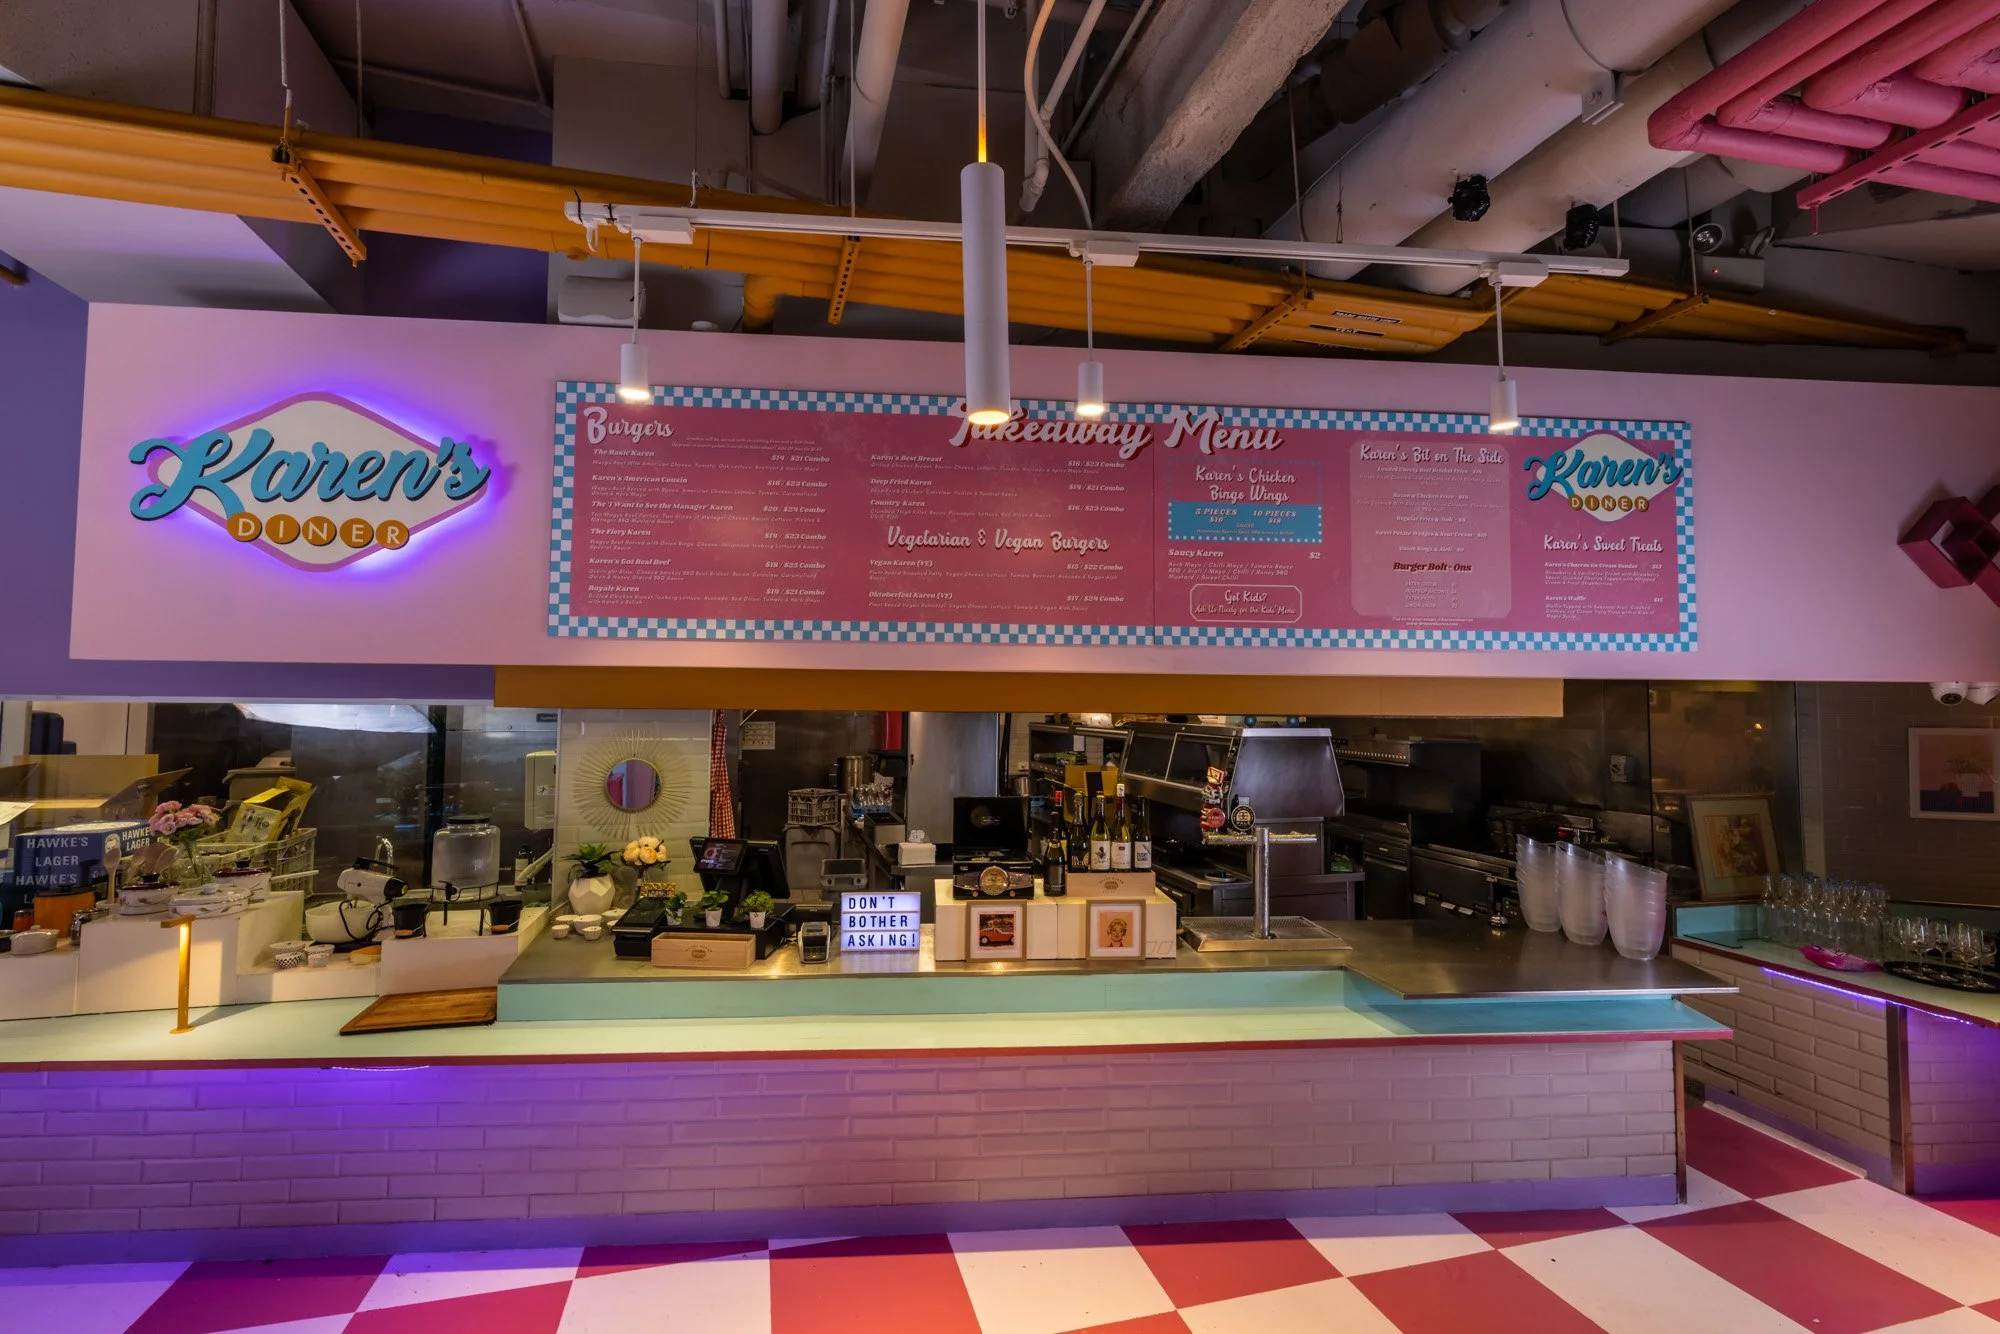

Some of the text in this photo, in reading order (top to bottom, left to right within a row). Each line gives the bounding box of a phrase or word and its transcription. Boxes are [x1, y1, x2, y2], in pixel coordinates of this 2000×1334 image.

[583, 406, 674, 444] Burgers
[1165, 406, 1283, 454] Menu
[593, 448, 608, 456] The
[631, 451, 655, 459] Karen
[804, 455, 831, 463] Combo
[1359, 443, 1407, 461] Karen's
[1412, 446, 1430, 463] Bit
[1454, 447, 1474, 463] The
[1477, 447, 1506, 463] Side
[128, 428, 491, 521] Karen's
[624, 475, 660, 483] American
[661, 476, 688, 484] Cousin
[1196, 465, 1296, 483] Karen's Chicken
[1523, 448, 1684, 501] Karen's
[801, 480, 828, 488] Combo
[870, 478, 888, 486] Deep
[888, 478, 909, 486] Fried
[1209, 484, 1289, 505] Bingo Wings
[1570, 497, 1647, 511] DINER
[1203, 508, 1237, 517] PIECES
[1264, 510, 1296, 518] PIECES
[237, 518, 401, 544] DINER
[605, 528, 627, 537] Fiery
[888, 525, 1110, 555] Vegetarian & Vegan Burgers
[1543, 533, 1663, 552] Karen's Sweet Treats
[1168, 549, 1224, 558] Saucy Karen
[621, 558, 634, 566] Got
[635, 558, 652, 566] Real
[870, 559, 892, 568] Vegan
[1393, 561, 1427, 573] Burger
[588, 585, 614, 593] Royale
[1224, 590, 1267, 604] Got Kids?
[1219, 605, 1237, 615] Nicely
[1277, 606, 1295, 614] Menu
[26, 836, 89, 849] HAWKE'S
[126, 838, 150, 851] LAGER
[35, 855, 79, 868] LAGER
[16, 873, 77, 886] HAWKE'S
[848, 896, 895, 909] DON'T
[849, 915, 908, 928] BOTHER
[848, 933, 915, 947] ASKING!
